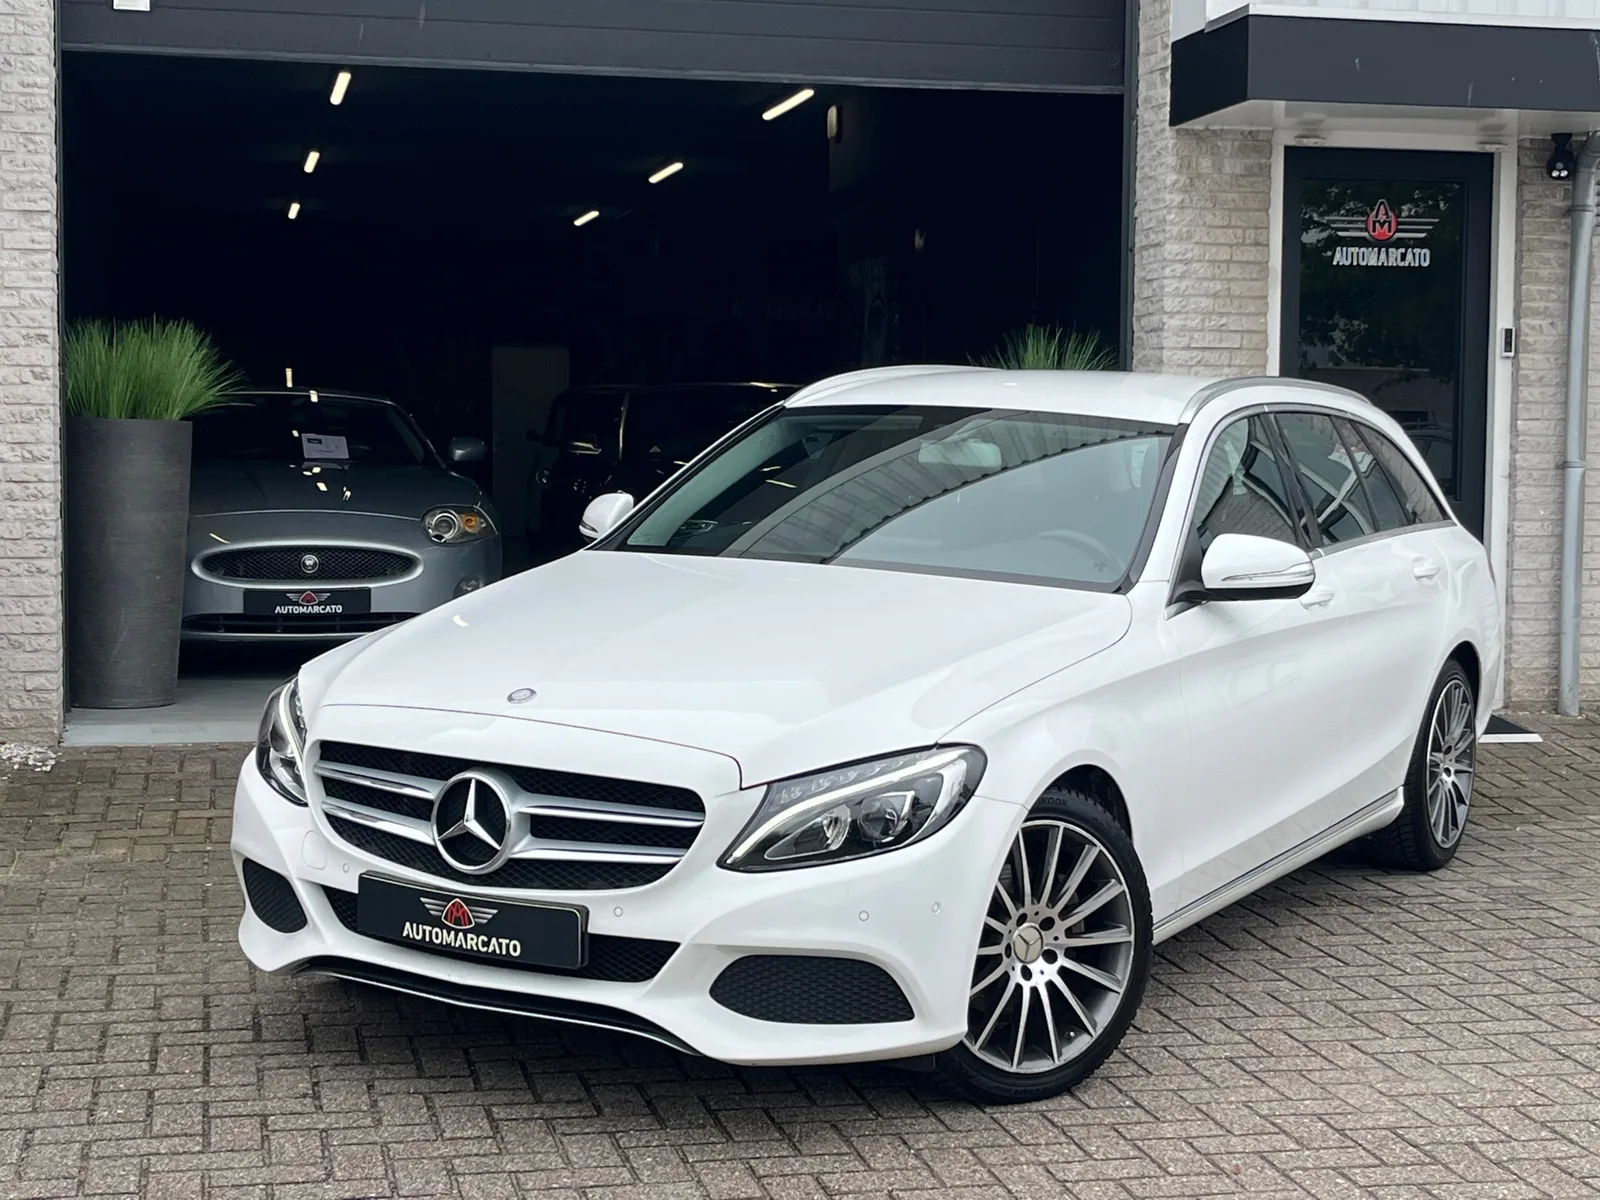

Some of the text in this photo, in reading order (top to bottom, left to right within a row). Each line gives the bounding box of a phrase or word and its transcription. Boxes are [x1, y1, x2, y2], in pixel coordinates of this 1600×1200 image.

[1332, 246, 1430, 267] AUTOMARCATO
[274, 605, 343, 614] AUTOMARCATO
[402, 921, 522, 957] AUTOMARCATO
